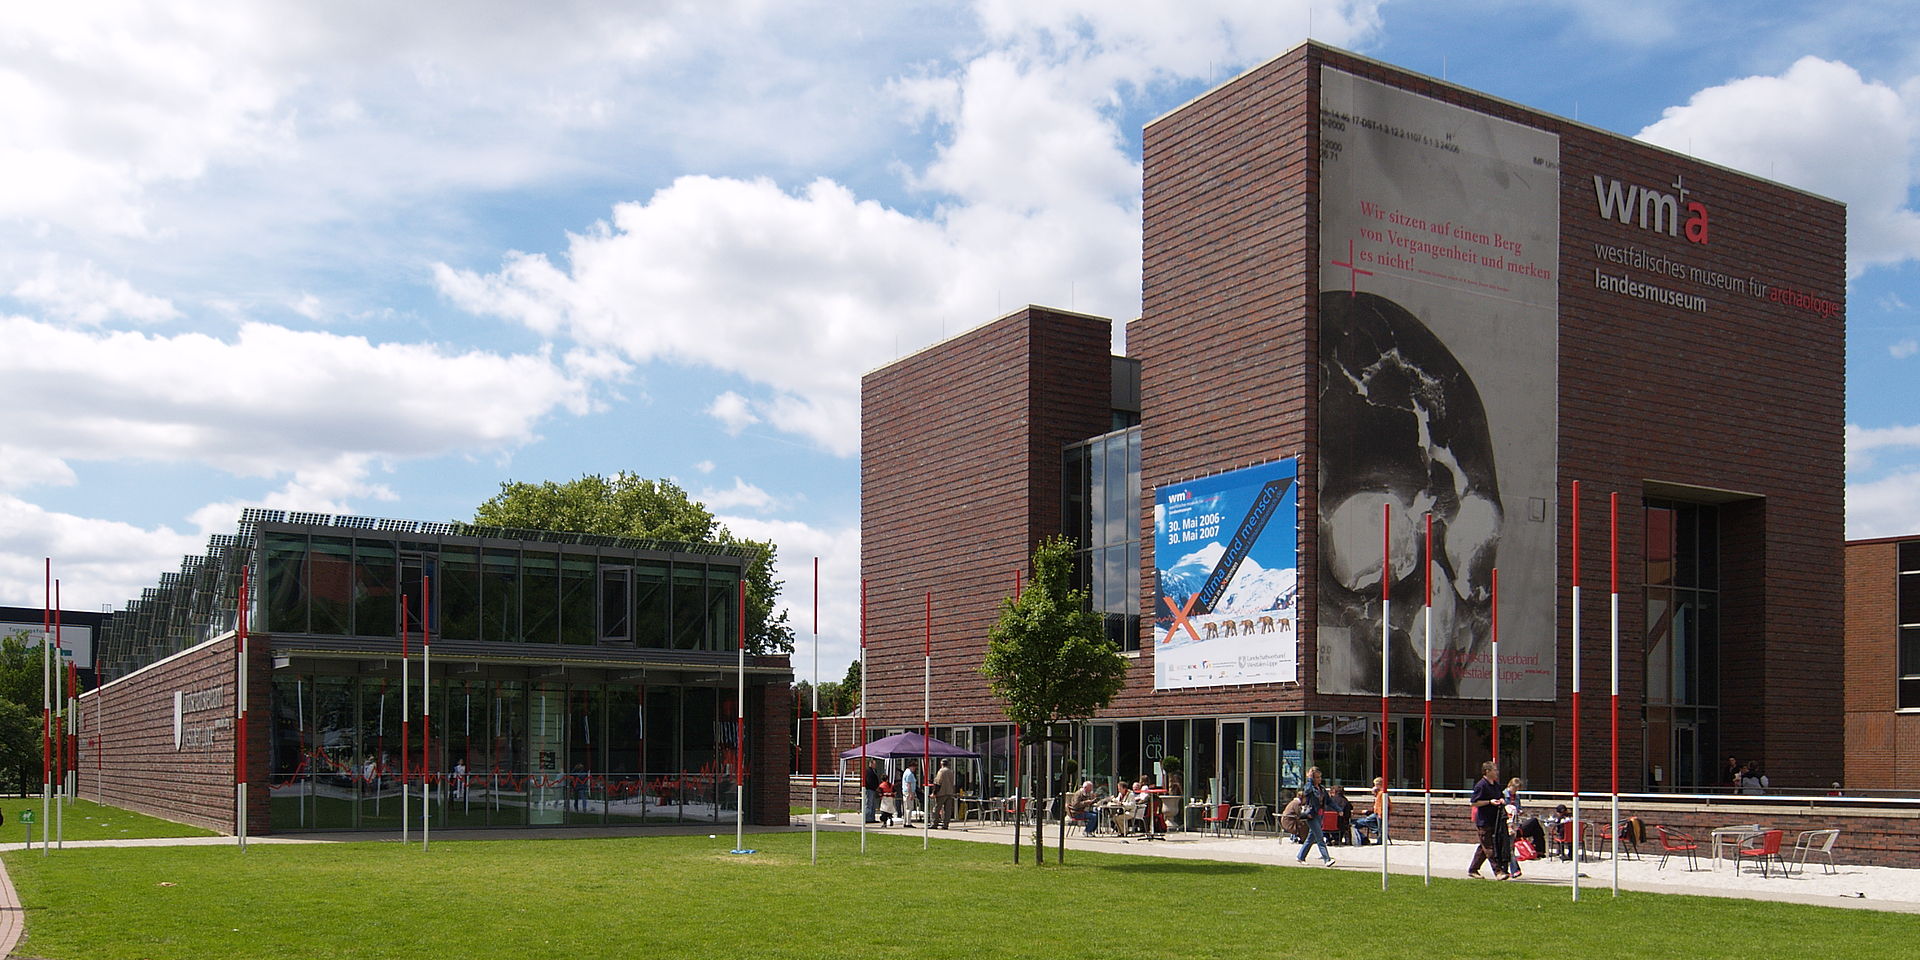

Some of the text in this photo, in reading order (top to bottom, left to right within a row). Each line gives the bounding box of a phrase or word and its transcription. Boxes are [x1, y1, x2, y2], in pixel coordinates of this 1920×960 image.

[1360, 200, 1522, 256] Wir sitzen auf einem Berg
[1360, 226, 1383, 242] von
[1387, 230, 1477, 264] Vergangenheit
[1481, 254, 1504, 270] und
[1507, 258, 1551, 280] merken
[1360, 250, 1415, 271] es nicht!
[1594, 242, 1841, 319] westfälisches museum für archäologie
[1595, 267, 1707, 313] landesmuseum
[1168, 520, 1181, 533] 30.
[1182, 516, 1198, 530] Mai
[1199, 512, 1220, 527] 2006
[1168, 525, 1220, 545] 30. Mai 2007
[1200, 484, 1278, 606] klima und mensch.
[1145, 743, 1163, 759] CR
